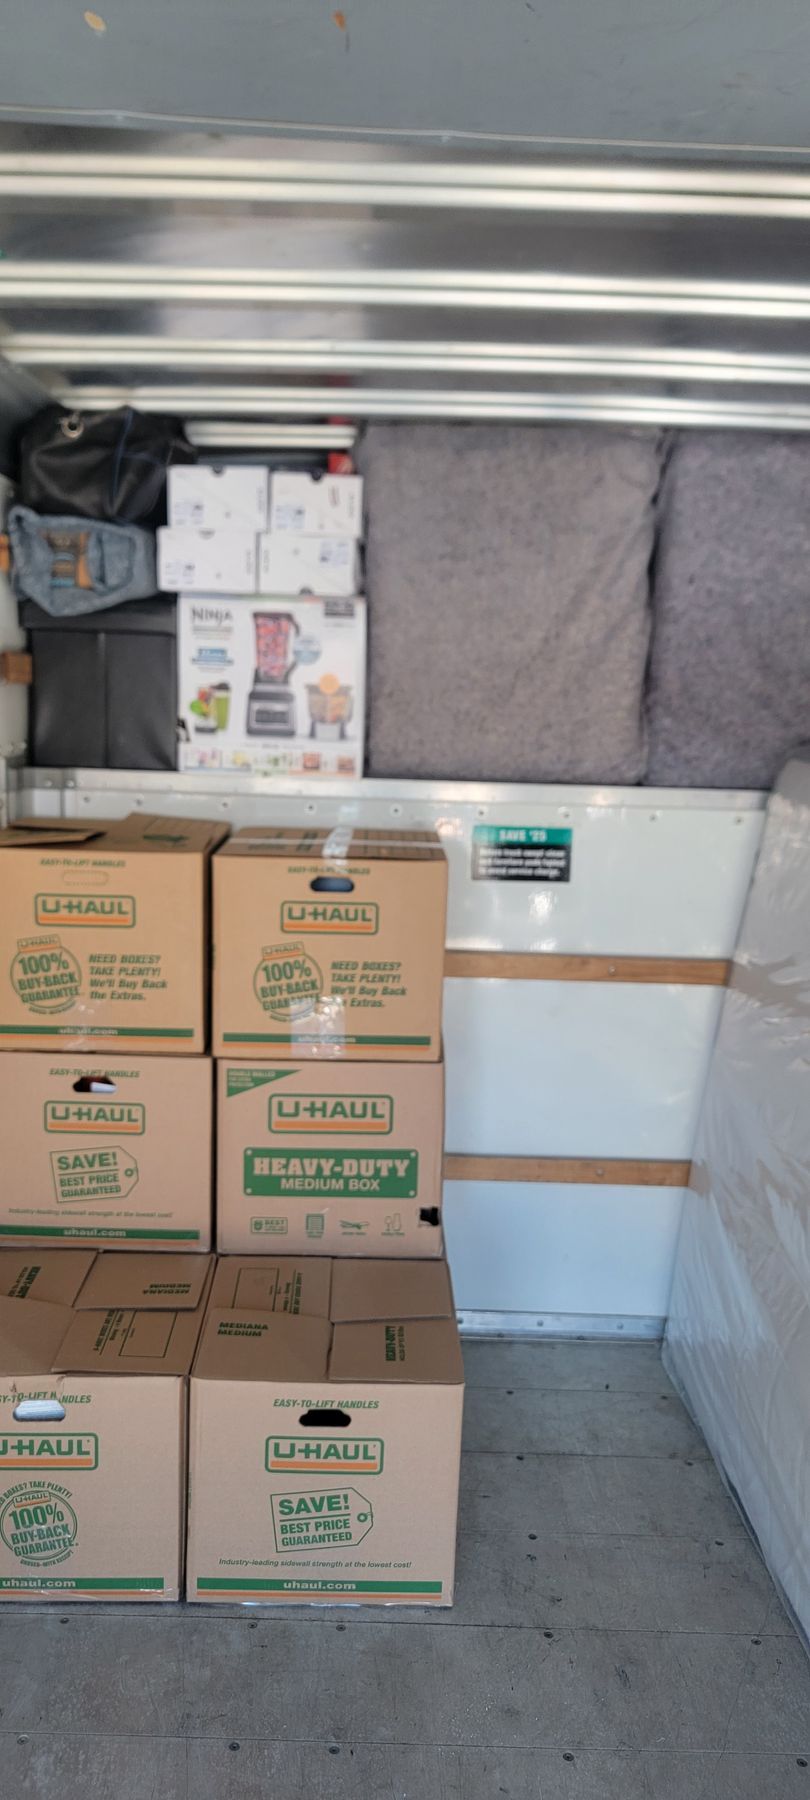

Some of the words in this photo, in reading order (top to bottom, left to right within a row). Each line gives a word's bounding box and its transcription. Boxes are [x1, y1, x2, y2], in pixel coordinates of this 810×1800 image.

[191, 606, 232, 624] NINJA
[499, 829, 526, 842] SAVE
[40, 859, 89, 867] EASY-TO-LIFT
[42, 899, 129, 915] U-HAUL
[288, 907, 372, 922] U-HAUL
[18, 952, 69, 975] 100%
[89, 954, 116, 964] NEED
[331, 961, 358, 970] NEED
[362, 961, 401, 971] BOXES?
[90, 967, 115, 976] TAKE
[262, 959, 312, 982] 100%
[17, 972, 77, 991] BUY-BACK
[90, 978, 115, 988] We'll
[119, 979, 138, 990] Buy
[142, 979, 167, 989] Back
[331, 974, 355, 983] TAKE
[359, 974, 401, 983] PLENTY!
[20, 986, 80, 1003] GUARANTEE
[260, 979, 319, 998] BUY-BACK
[359, 986, 377, 996] Buy
[381, 986, 407, 996] Back
[90, 991, 107, 1000] the
[110, 991, 146, 1001] Extras.
[350, 999, 385, 1007] Extras.
[49, 1068, 103, 1077] EASY-TO-LIFT
[105, 1070, 140, 1078] HANDLES
[51, 1106, 138, 1122] U-HAUL
[277, 1101, 385, 1118] U-HAUL
[58, 1152, 118, 1171] SAVE!
[253, 1157, 409, 1177] HEAVY-DUTY
[60, 1175, 85, 1187] BEST
[89, 1172, 119, 1185] PRICE
[280, 1178, 344, 1190] MEDIUM
[350, 1179, 380, 1191] BOX
[61, 1185, 121, 1198] GUARANTEED
[64, 1228, 126, 1237] uhaul.com
[217, 1329, 262, 1337] MEDIUM
[219, 1322, 268, 1331] MEDIANA
[273, 1399, 335, 1409] EASY-TO-LIFT
[337, 1400, 379, 1409] HANDLES
[273, 1442, 376, 1461] U-HAUL
[29, 1481, 46, 1489] TAKE
[47, 1482, 73, 1499] PLENTY!
[15, 1493, 48, 1502] U-HAUL
[279, 1494, 350, 1516] SAVE!
[9, 1503, 65, 1530] 100%
[280, 1522, 311, 1535] BEST
[315, 1519, 351, 1532] PRICE
[11, 1523, 71, 1546] BUY-BACK
[281, 1531, 352, 1547] GUARANTEED
[14, 1537, 75, 1557] GUARANTEE
[219, 1557, 279, 1567] Industry-leading
[281, 1559, 310, 1567] sidewall
[312, 1559, 343, 1568] strength
[2, 1579, 76, 1588] uhaul.com
[283, 1581, 356, 1590] uhaul.com
